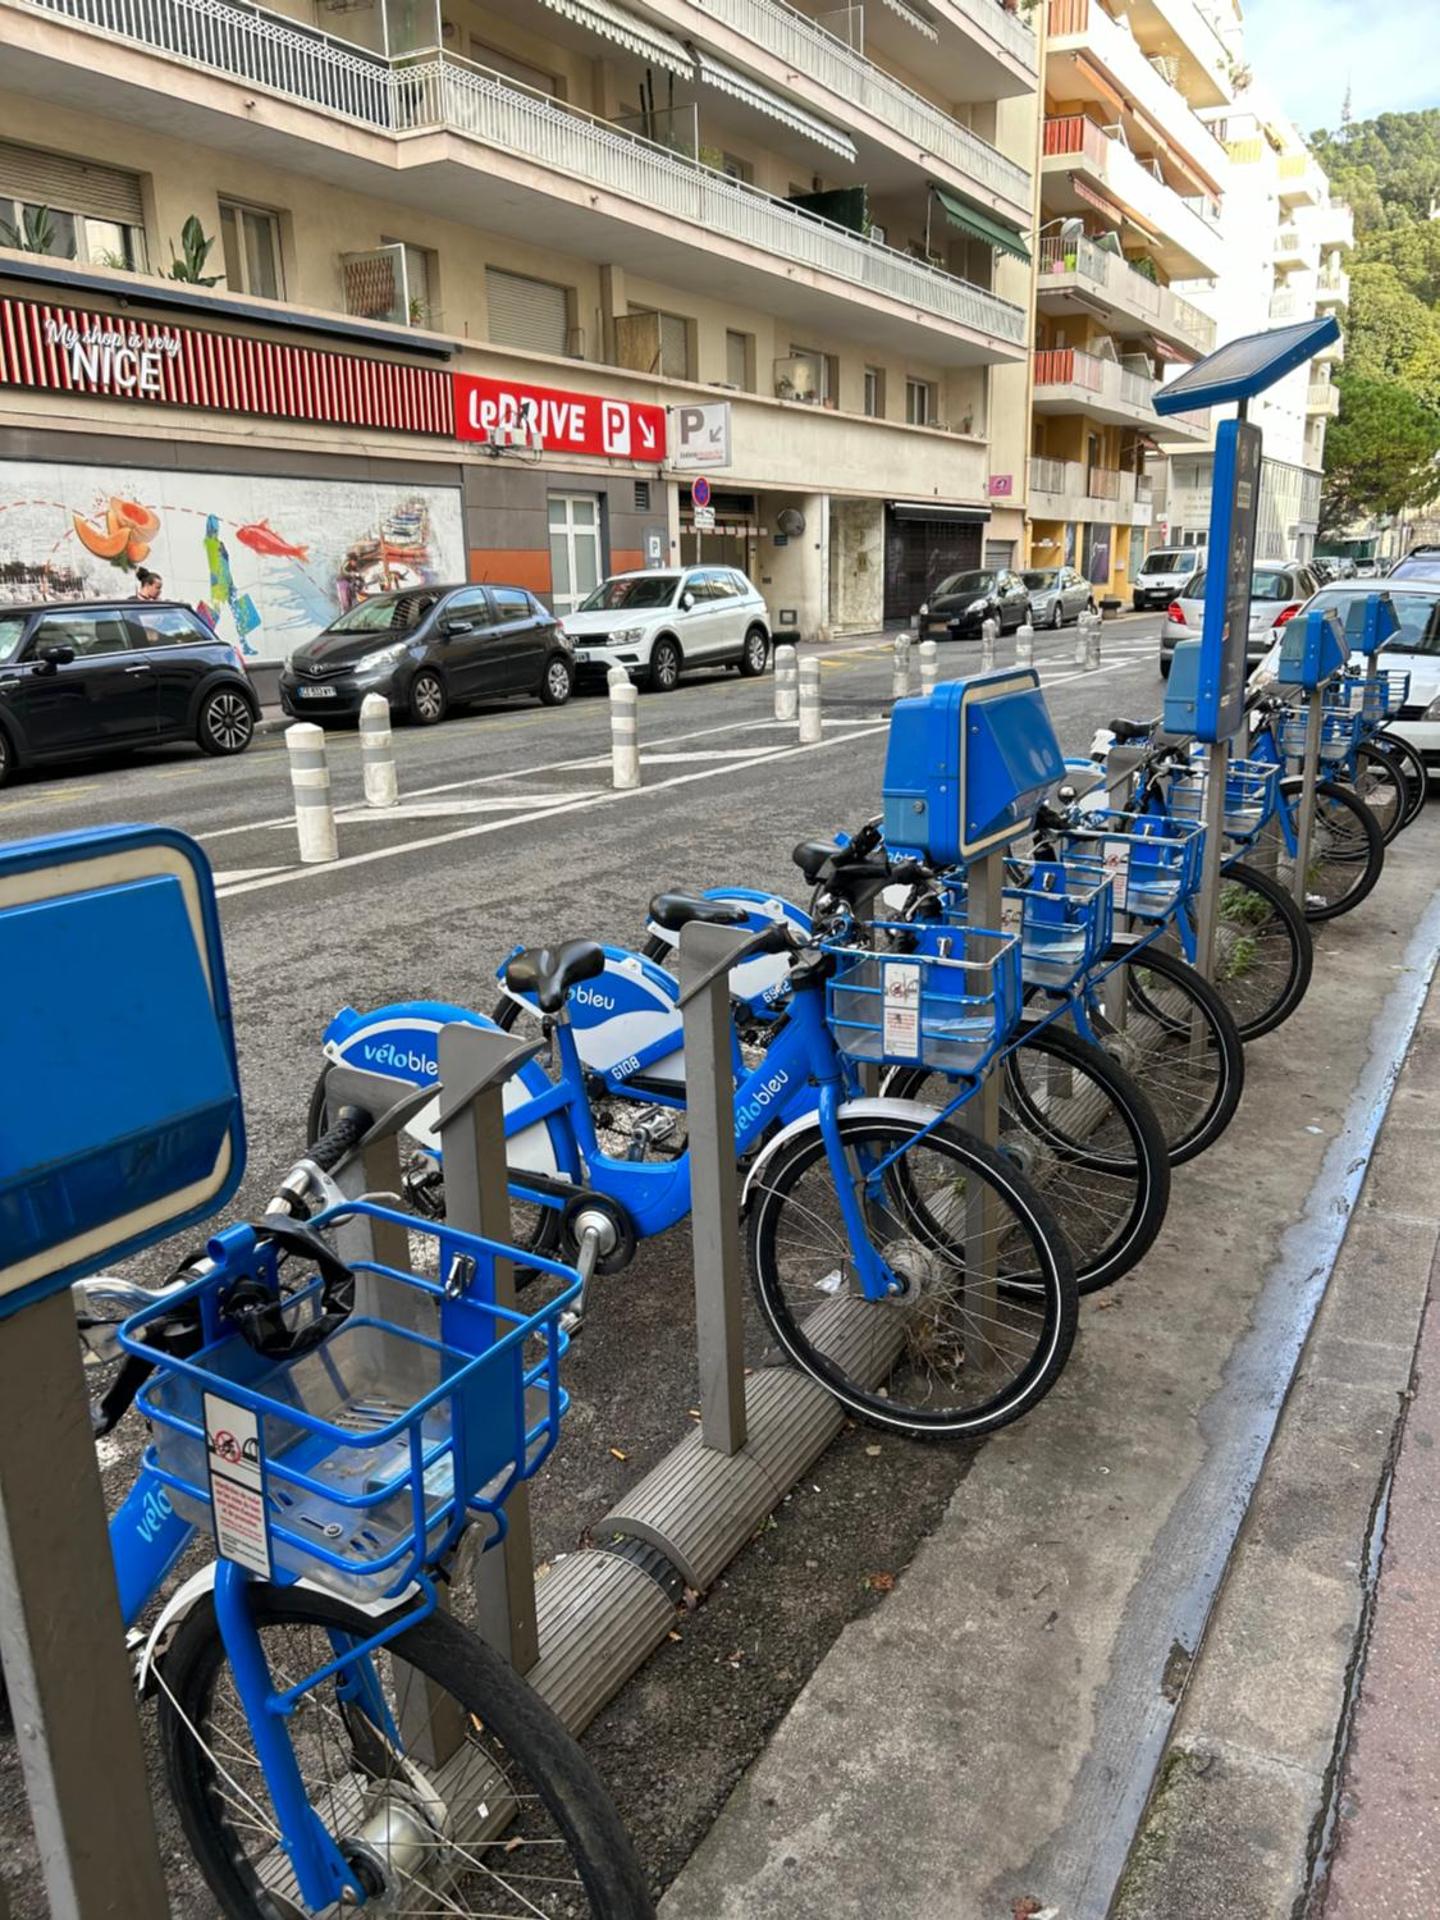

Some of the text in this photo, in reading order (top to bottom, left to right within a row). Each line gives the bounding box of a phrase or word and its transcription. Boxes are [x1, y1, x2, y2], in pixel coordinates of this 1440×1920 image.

[44, 318, 182, 358] My shop is very
[72, 342, 162, 391] NICE
[607, 406, 625, 448] P
[680, 408, 705, 445] P
[364, 1043, 439, 1076] véloble
[611, 1055, 640, 1080] 6108
[136, 1488, 173, 1543] vélo
